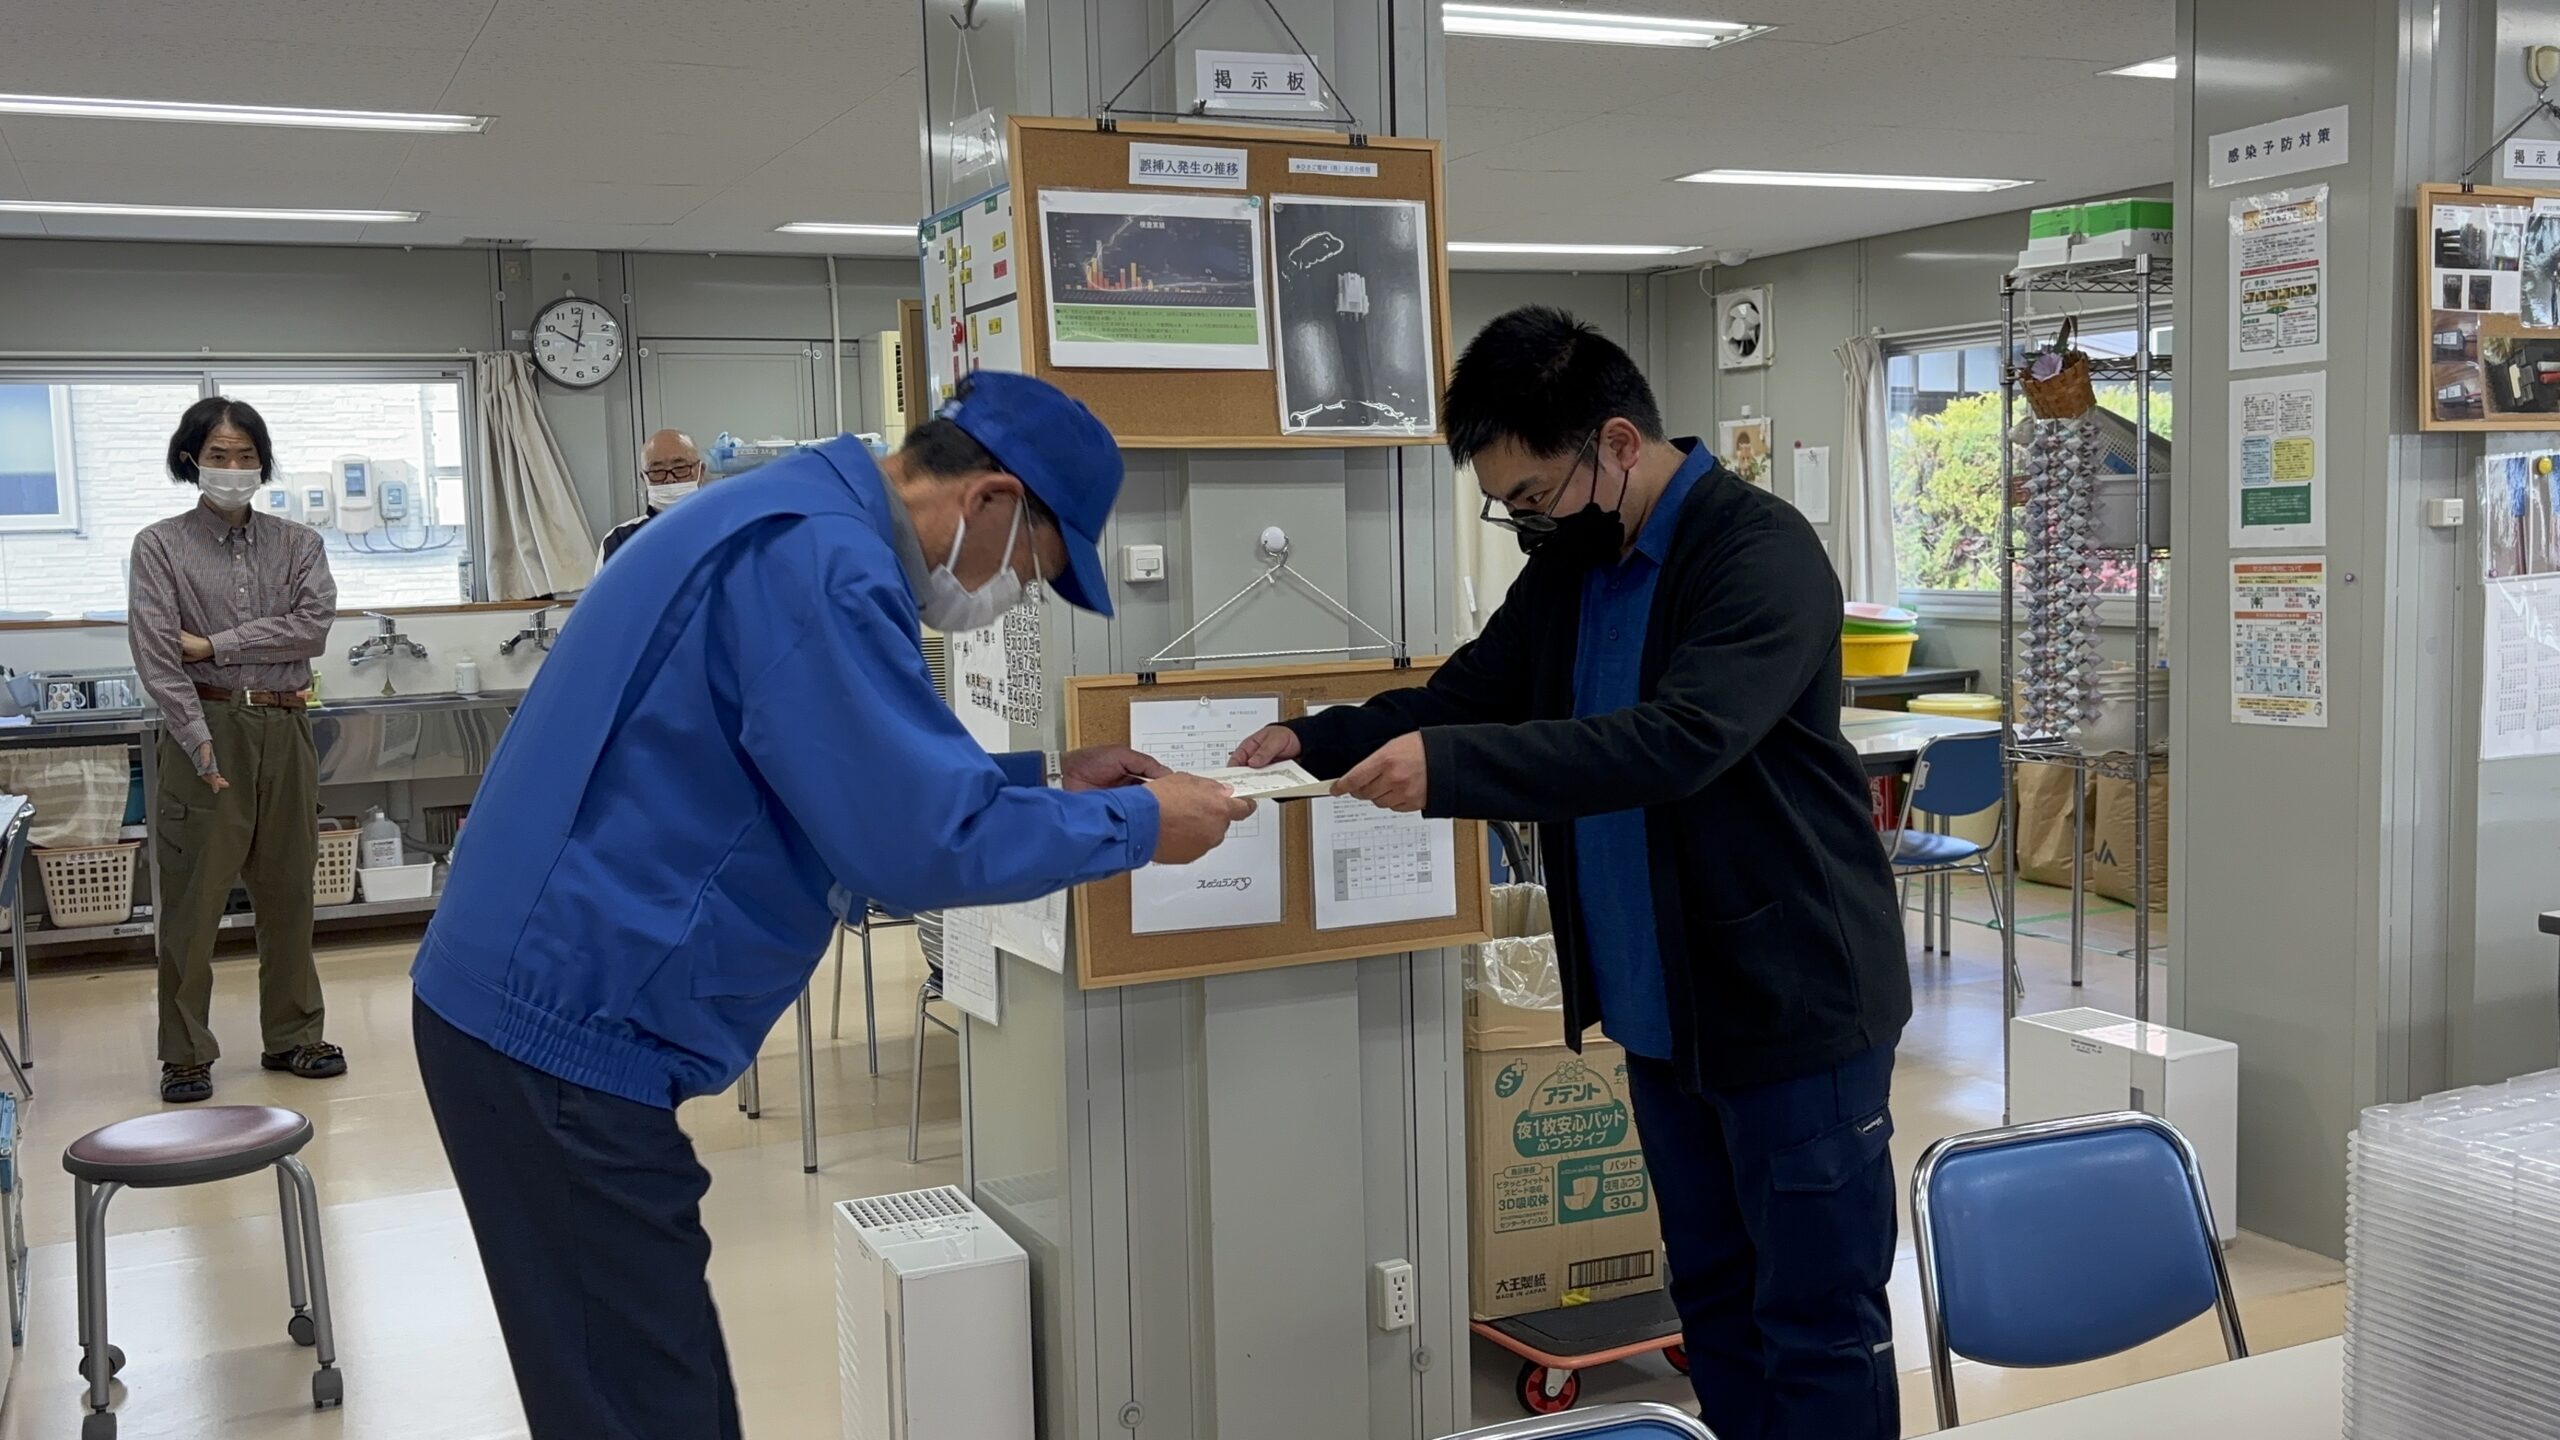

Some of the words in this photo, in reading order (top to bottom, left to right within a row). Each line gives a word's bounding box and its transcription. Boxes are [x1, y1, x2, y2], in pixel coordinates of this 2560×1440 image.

[1214, 69, 1305, 91] 掲示板
[2227, 127, 2331, 163] 感染予防対策
[2514, 149, 2560, 165] 掲示
[1139, 158, 1239, 176] 誤挿入発生の推移
[571, 307, 582, 315] 12
[591, 312, 596, 320] 1
[545, 325, 556, 333] 10
[601, 324, 610, 332] 2
[541, 339, 551, 347] 9
[606, 339, 614, 347] 3
[547, 354, 556, 362] 8
[560, 366, 568, 375] 7
[576, 370, 585, 379] 6
[591, 366, 600, 374] 5
[1499, 1072, 1514, 1090] S
[1543, 1082, 1601, 1105] アテント
[1517, 1108, 1625, 1140] 夜1枚安心パッド
[1537, 1130, 1608, 1152] ふつうタイプ
[1610, 1158, 1637, 1171] パッド
[1498, 1193, 1549, 1211] 3D吸収体
[1496, 1273, 1547, 1294] 大王製紙
[1525, 1287, 1547, 1296] JAPAN
